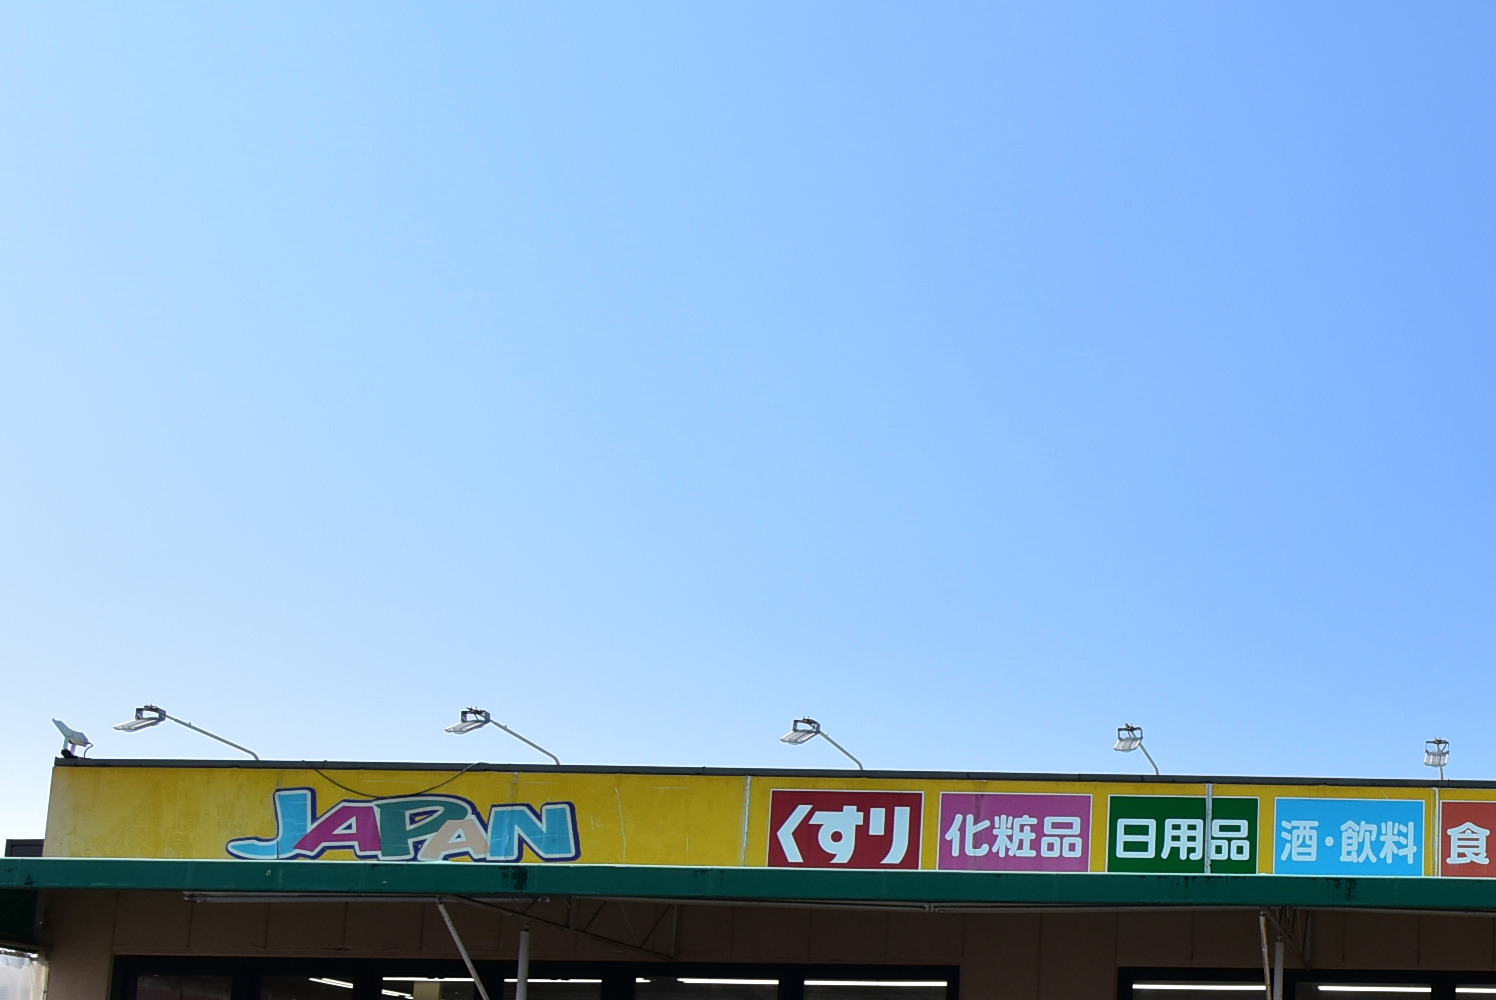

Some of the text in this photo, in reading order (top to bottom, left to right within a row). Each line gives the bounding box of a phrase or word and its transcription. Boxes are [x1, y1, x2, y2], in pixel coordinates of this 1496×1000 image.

[226, 787, 581, 862] JAPAN
[776, 804, 911, 864] くすり
[945, 813, 1083, 859] 化粧品
[1115, 818, 1250, 862] 日用品
[1280, 820, 1417, 865] 酒・飲料
